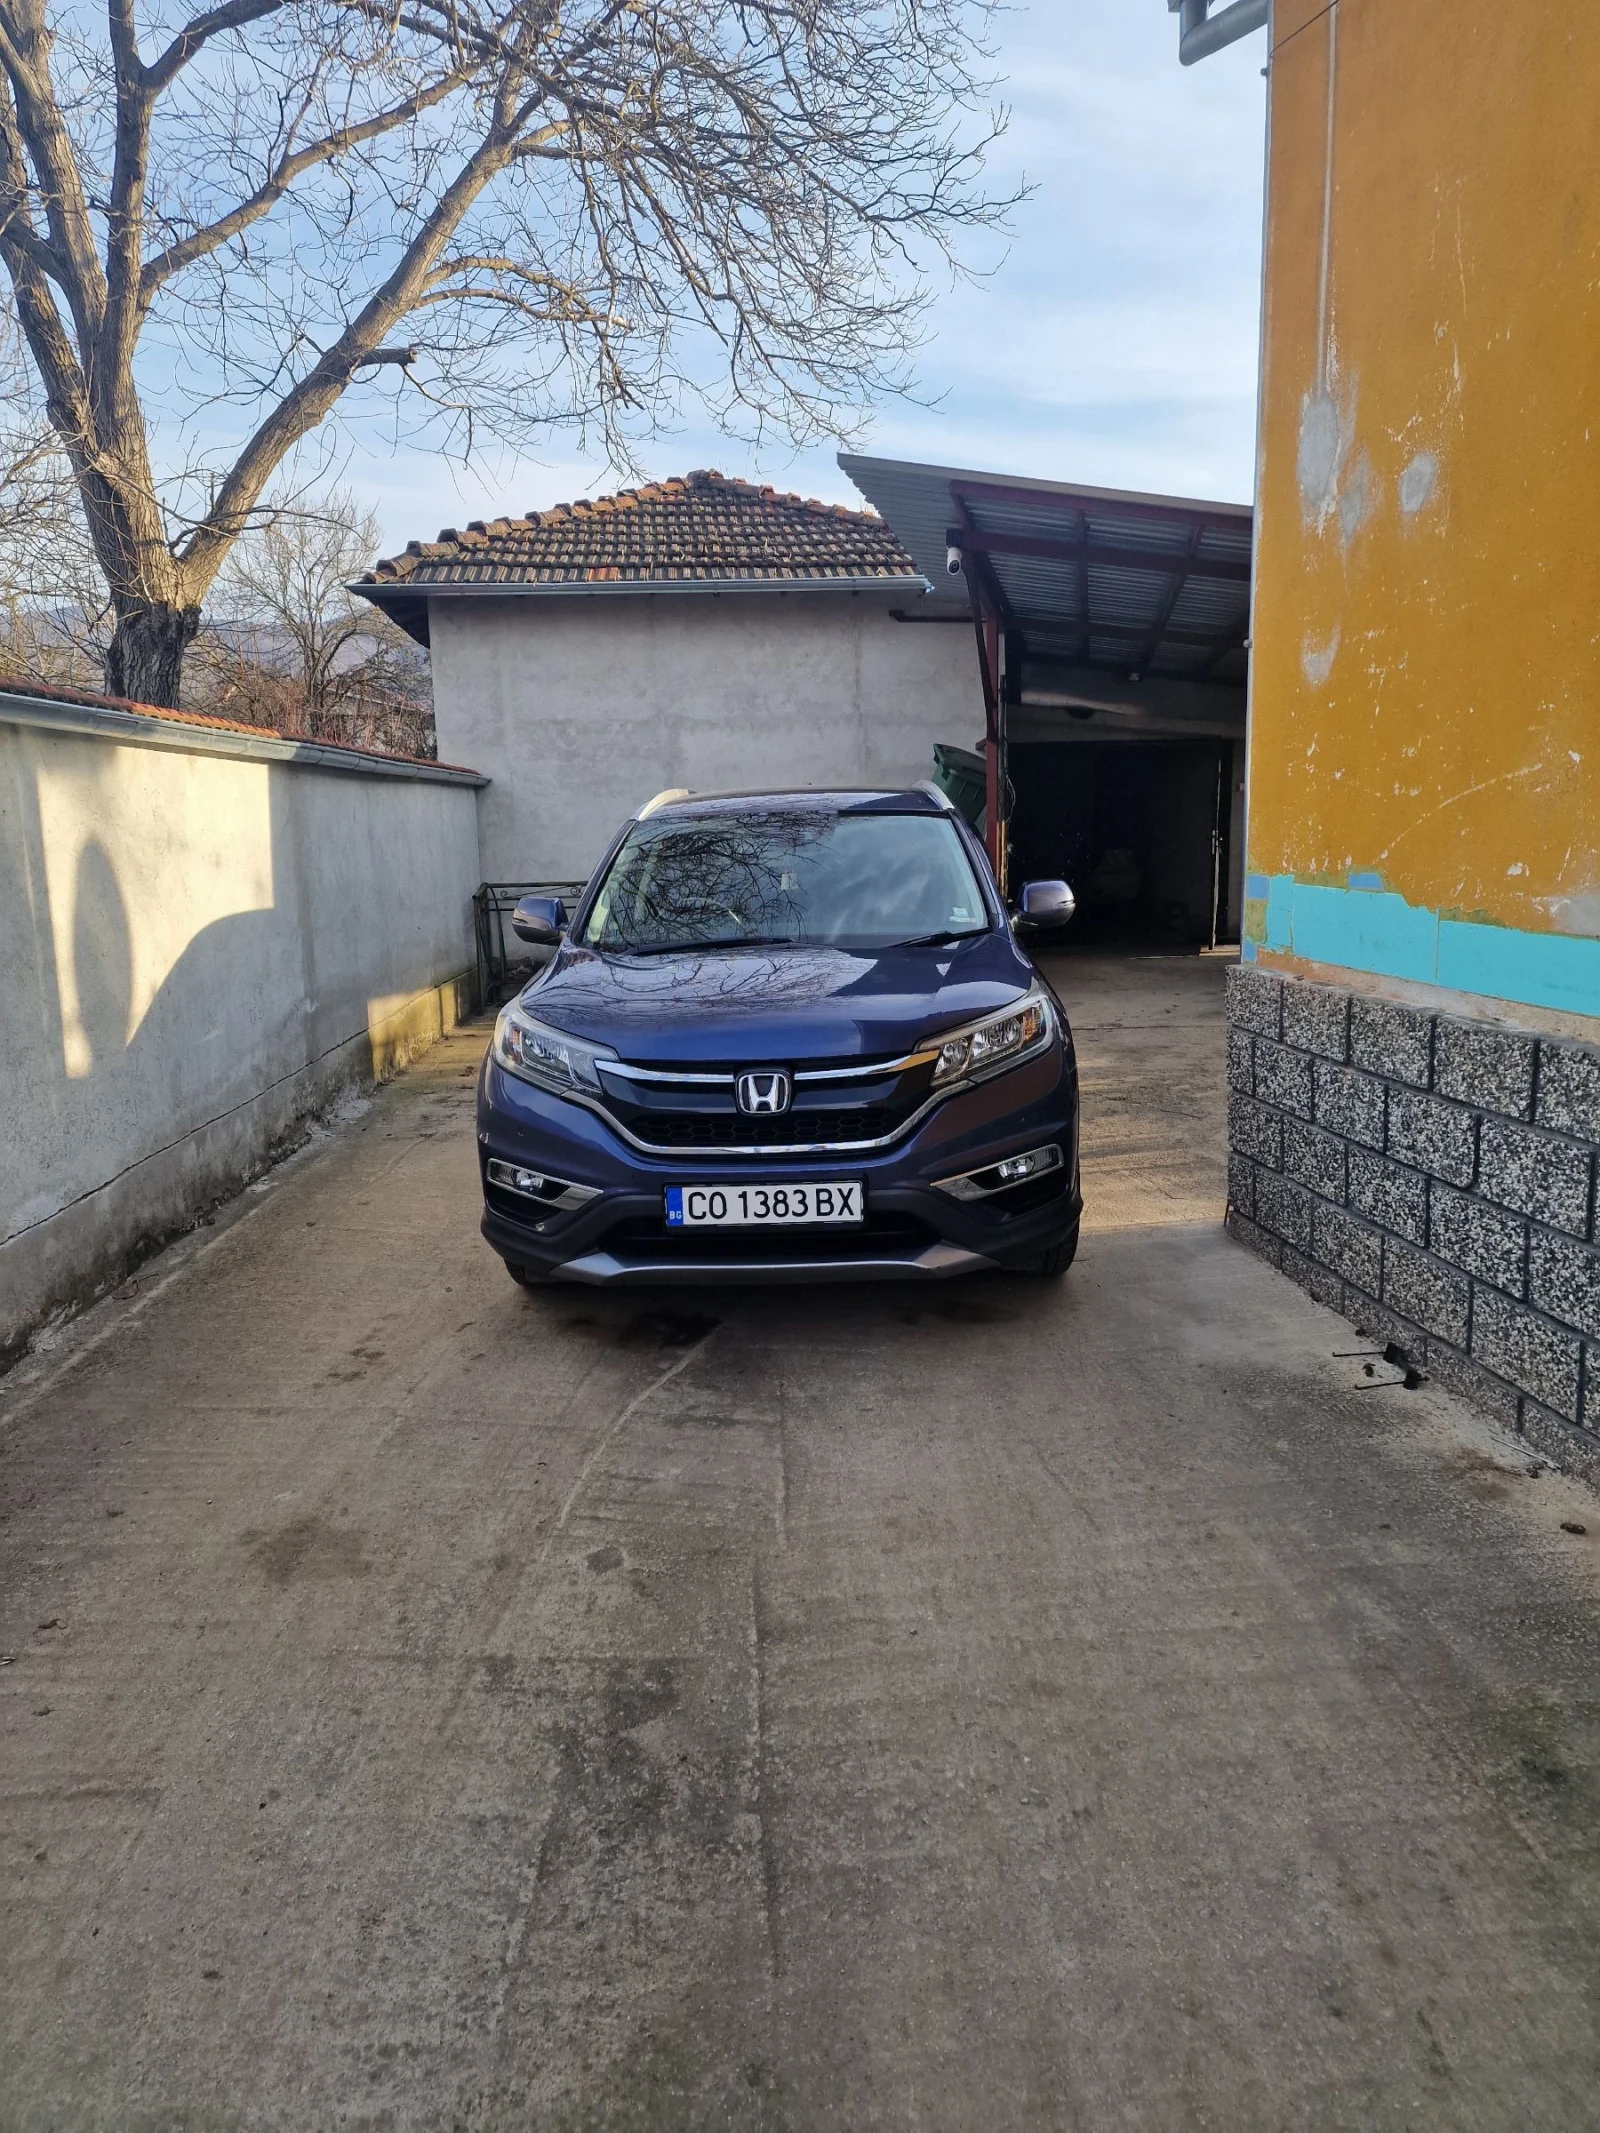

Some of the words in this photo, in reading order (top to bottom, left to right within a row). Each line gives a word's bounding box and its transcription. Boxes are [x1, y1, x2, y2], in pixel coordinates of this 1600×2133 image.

[688, 1191, 727, 1220] CO
[738, 1189, 808, 1219] 1383
[815, 1187, 854, 1217] BX
[669, 1210, 682, 1220] BG
